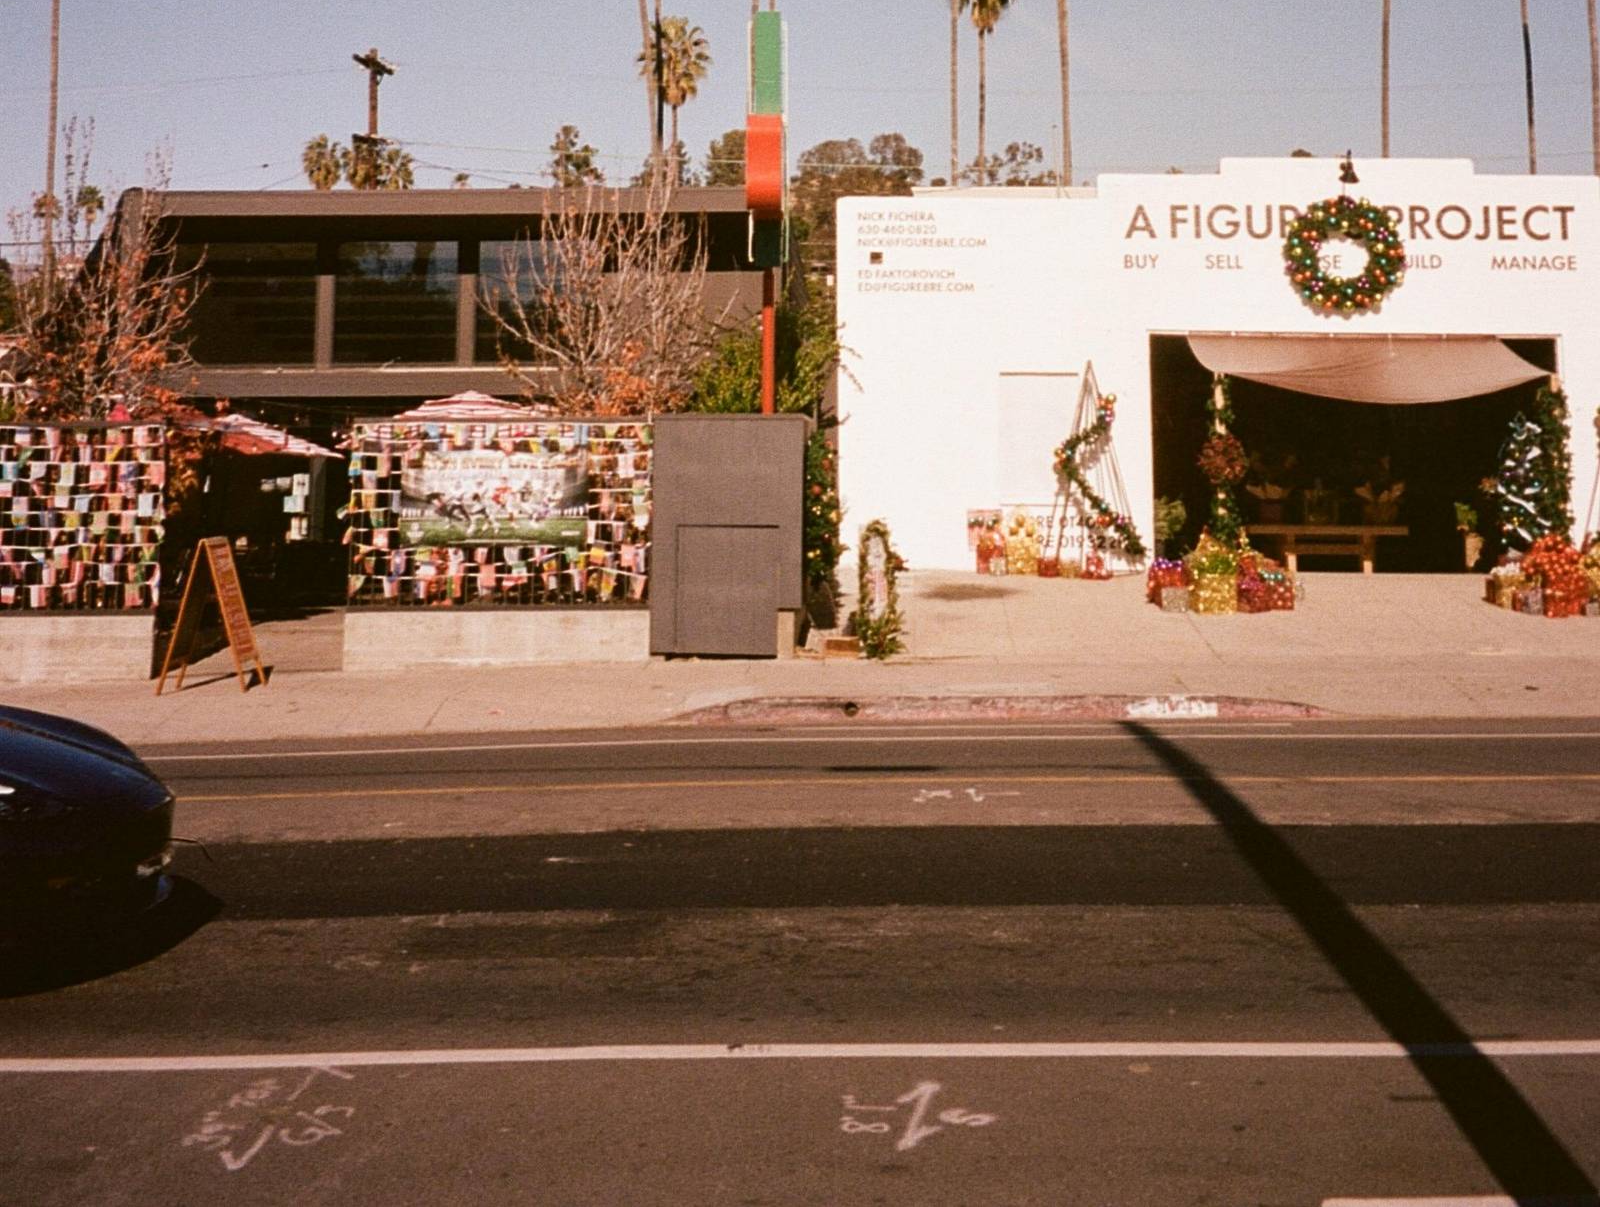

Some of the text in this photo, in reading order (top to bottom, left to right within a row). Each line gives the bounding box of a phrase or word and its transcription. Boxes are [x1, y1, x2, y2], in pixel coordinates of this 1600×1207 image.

[857, 211, 883, 221] NICK
[1125, 204, 1158, 240] A
[1169, 204, 1302, 240] FIGUR
[1123, 254, 1578, 271] BUY SELL SE UILD MANAGE
[858, 269, 873, 279] ED
